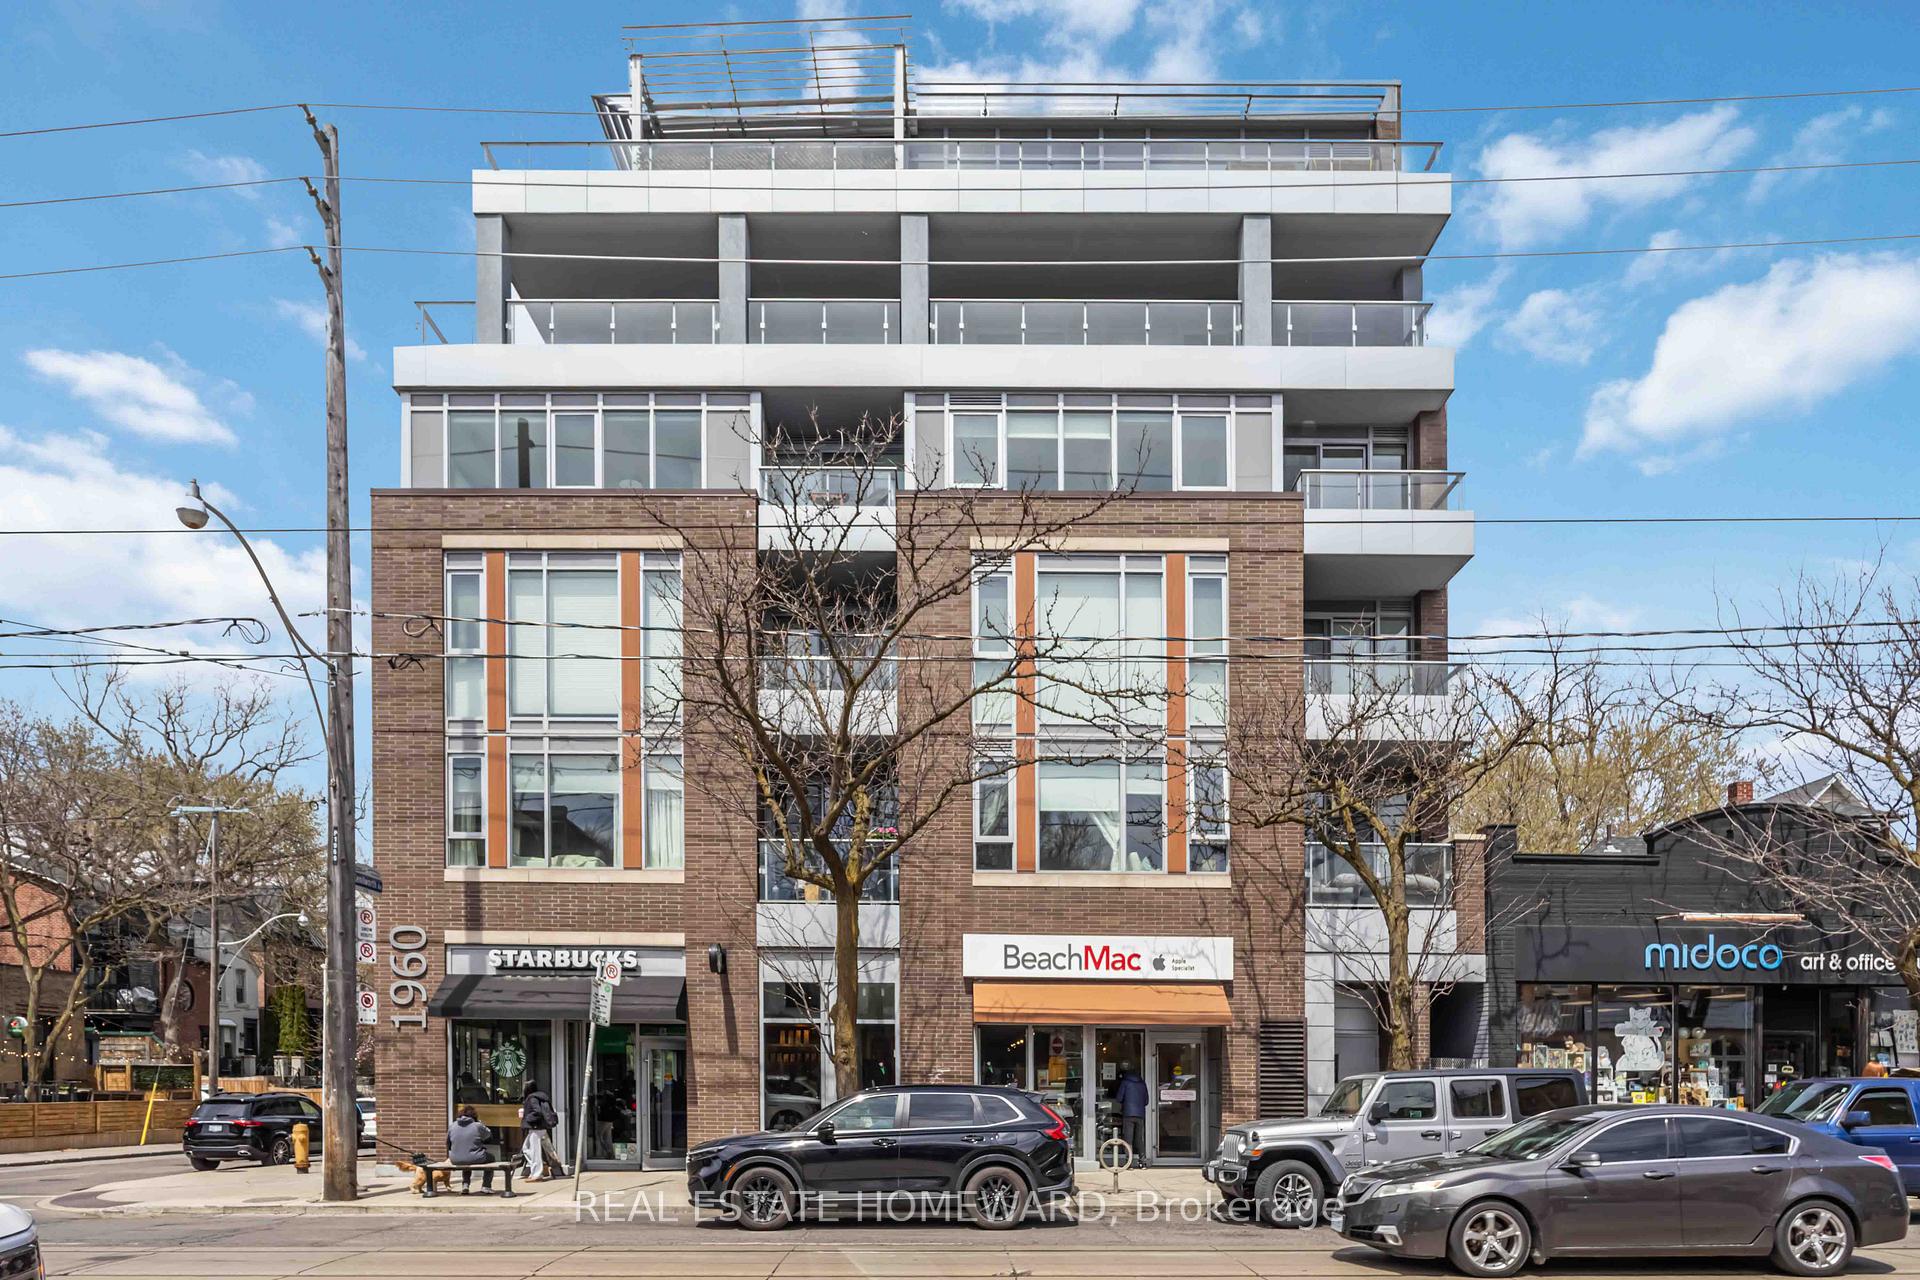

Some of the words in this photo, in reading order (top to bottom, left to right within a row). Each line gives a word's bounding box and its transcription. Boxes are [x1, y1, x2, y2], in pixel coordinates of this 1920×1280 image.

[488, 949, 638, 968] STARBUCKS
[1003, 943, 1142, 972] BeachMac
[1172, 957, 1187, 965] Apple
[1644, 934, 1783, 970] midoco
[1801, 954, 1825, 971] art
[1830, 954, 1842, 970] &
[1847, 953, 1896, 971] office
[390, 925, 428, 1028] 1960
